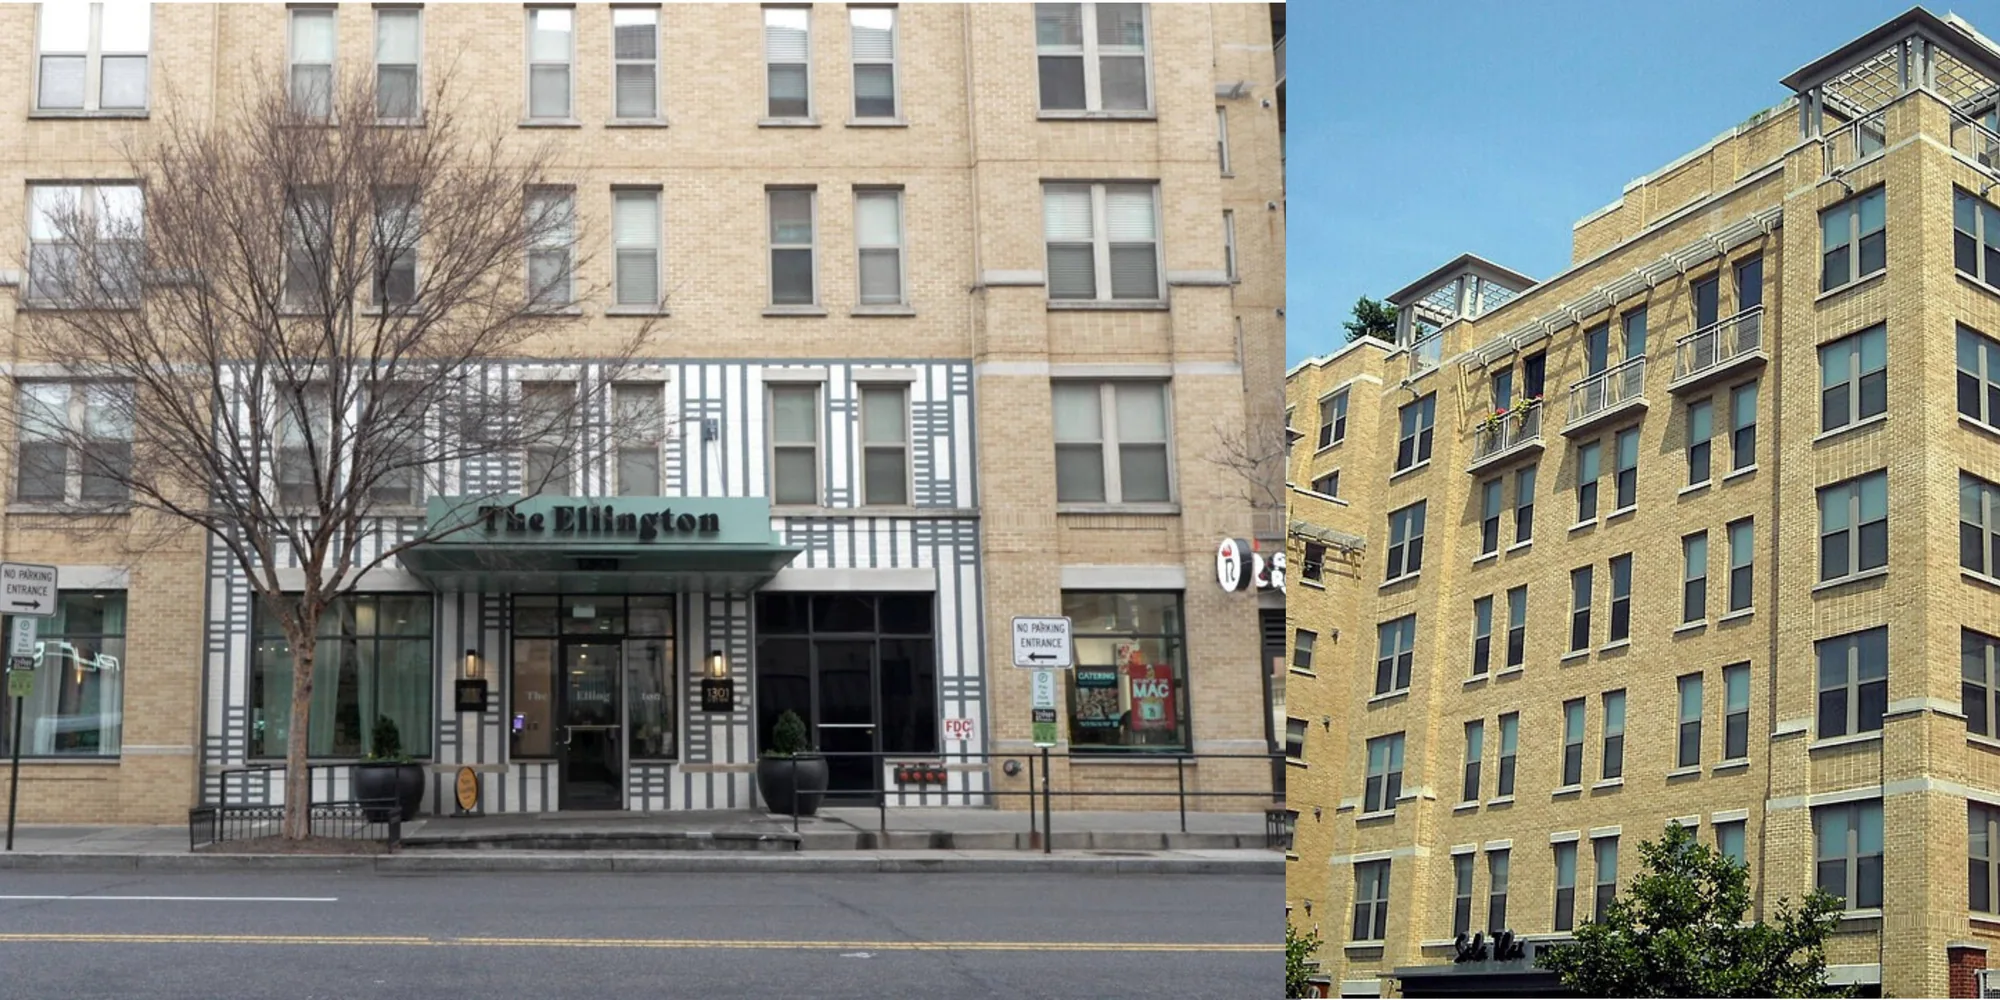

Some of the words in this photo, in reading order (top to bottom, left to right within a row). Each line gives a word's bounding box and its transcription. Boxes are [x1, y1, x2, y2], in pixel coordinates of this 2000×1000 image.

[478, 504, 545, 532] The
[552, 504, 720, 540] Ellington
[4, 568, 16, 580] NO
[18, 568, 53, 583] PARKING
[6, 583, 48, 597] ENTRANCE
[1016, 622, 1029, 634] NO
[1031, 621, 1066, 634] PARKING
[1020, 637, 1063, 649] ENTRANCE
[1077, 672, 1116, 681] CATERING
[707, 687, 729, 698] 1301
[1132, 683, 1170, 698] MAC
[945, 720, 972, 732] FDC
